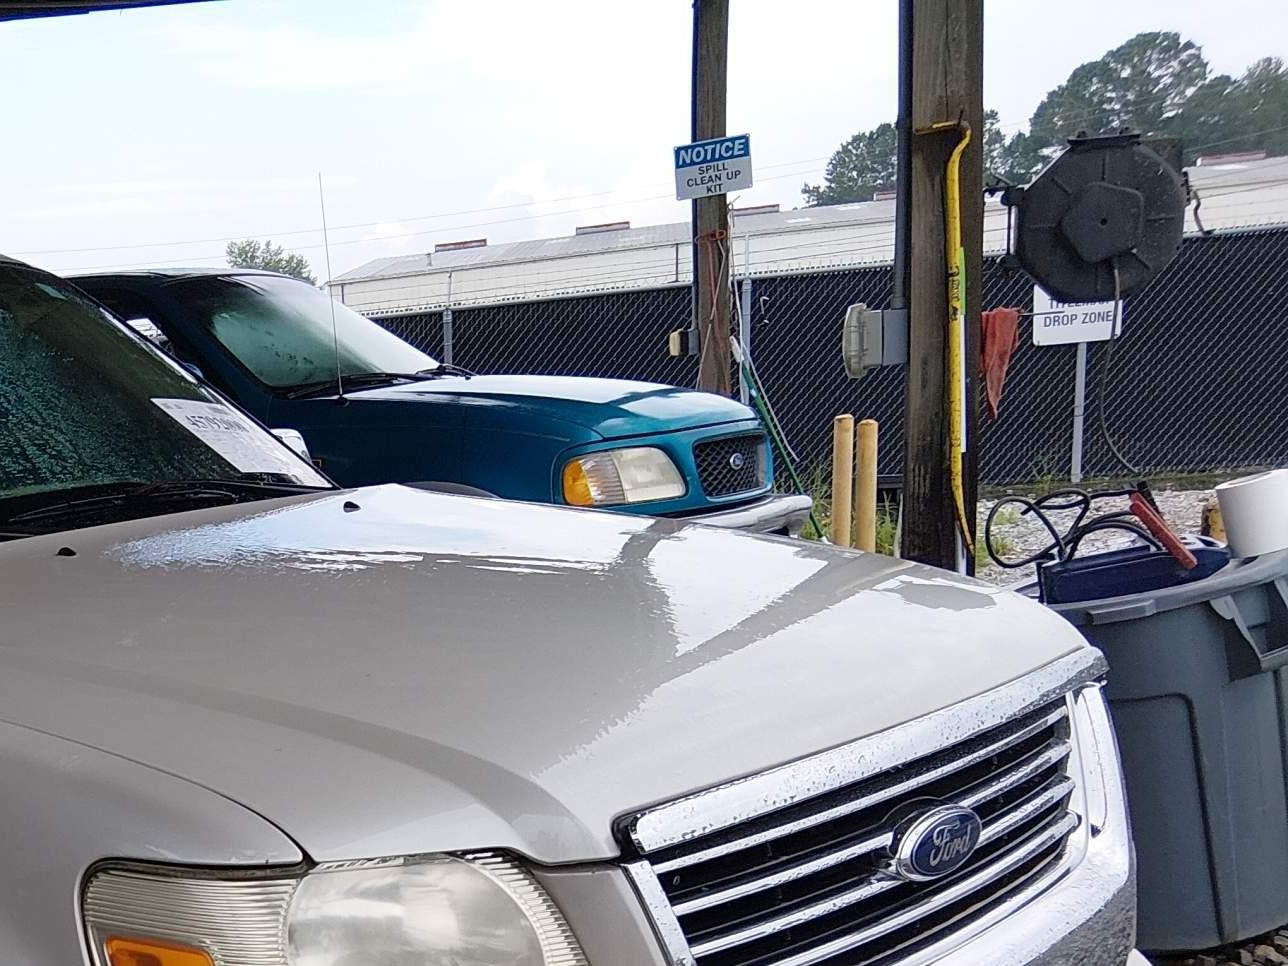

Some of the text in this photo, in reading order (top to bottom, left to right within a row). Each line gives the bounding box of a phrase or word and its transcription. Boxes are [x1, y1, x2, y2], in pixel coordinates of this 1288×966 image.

[678, 138, 746, 166] NOTICE
[698, 162, 728, 175] SPILL
[687, 170, 741, 188] CLEAN UP
[706, 183, 723, 194] KIT
[1043, 310, 1113, 328] DROP ZONE
[929, 820, 971, 867] Ford
